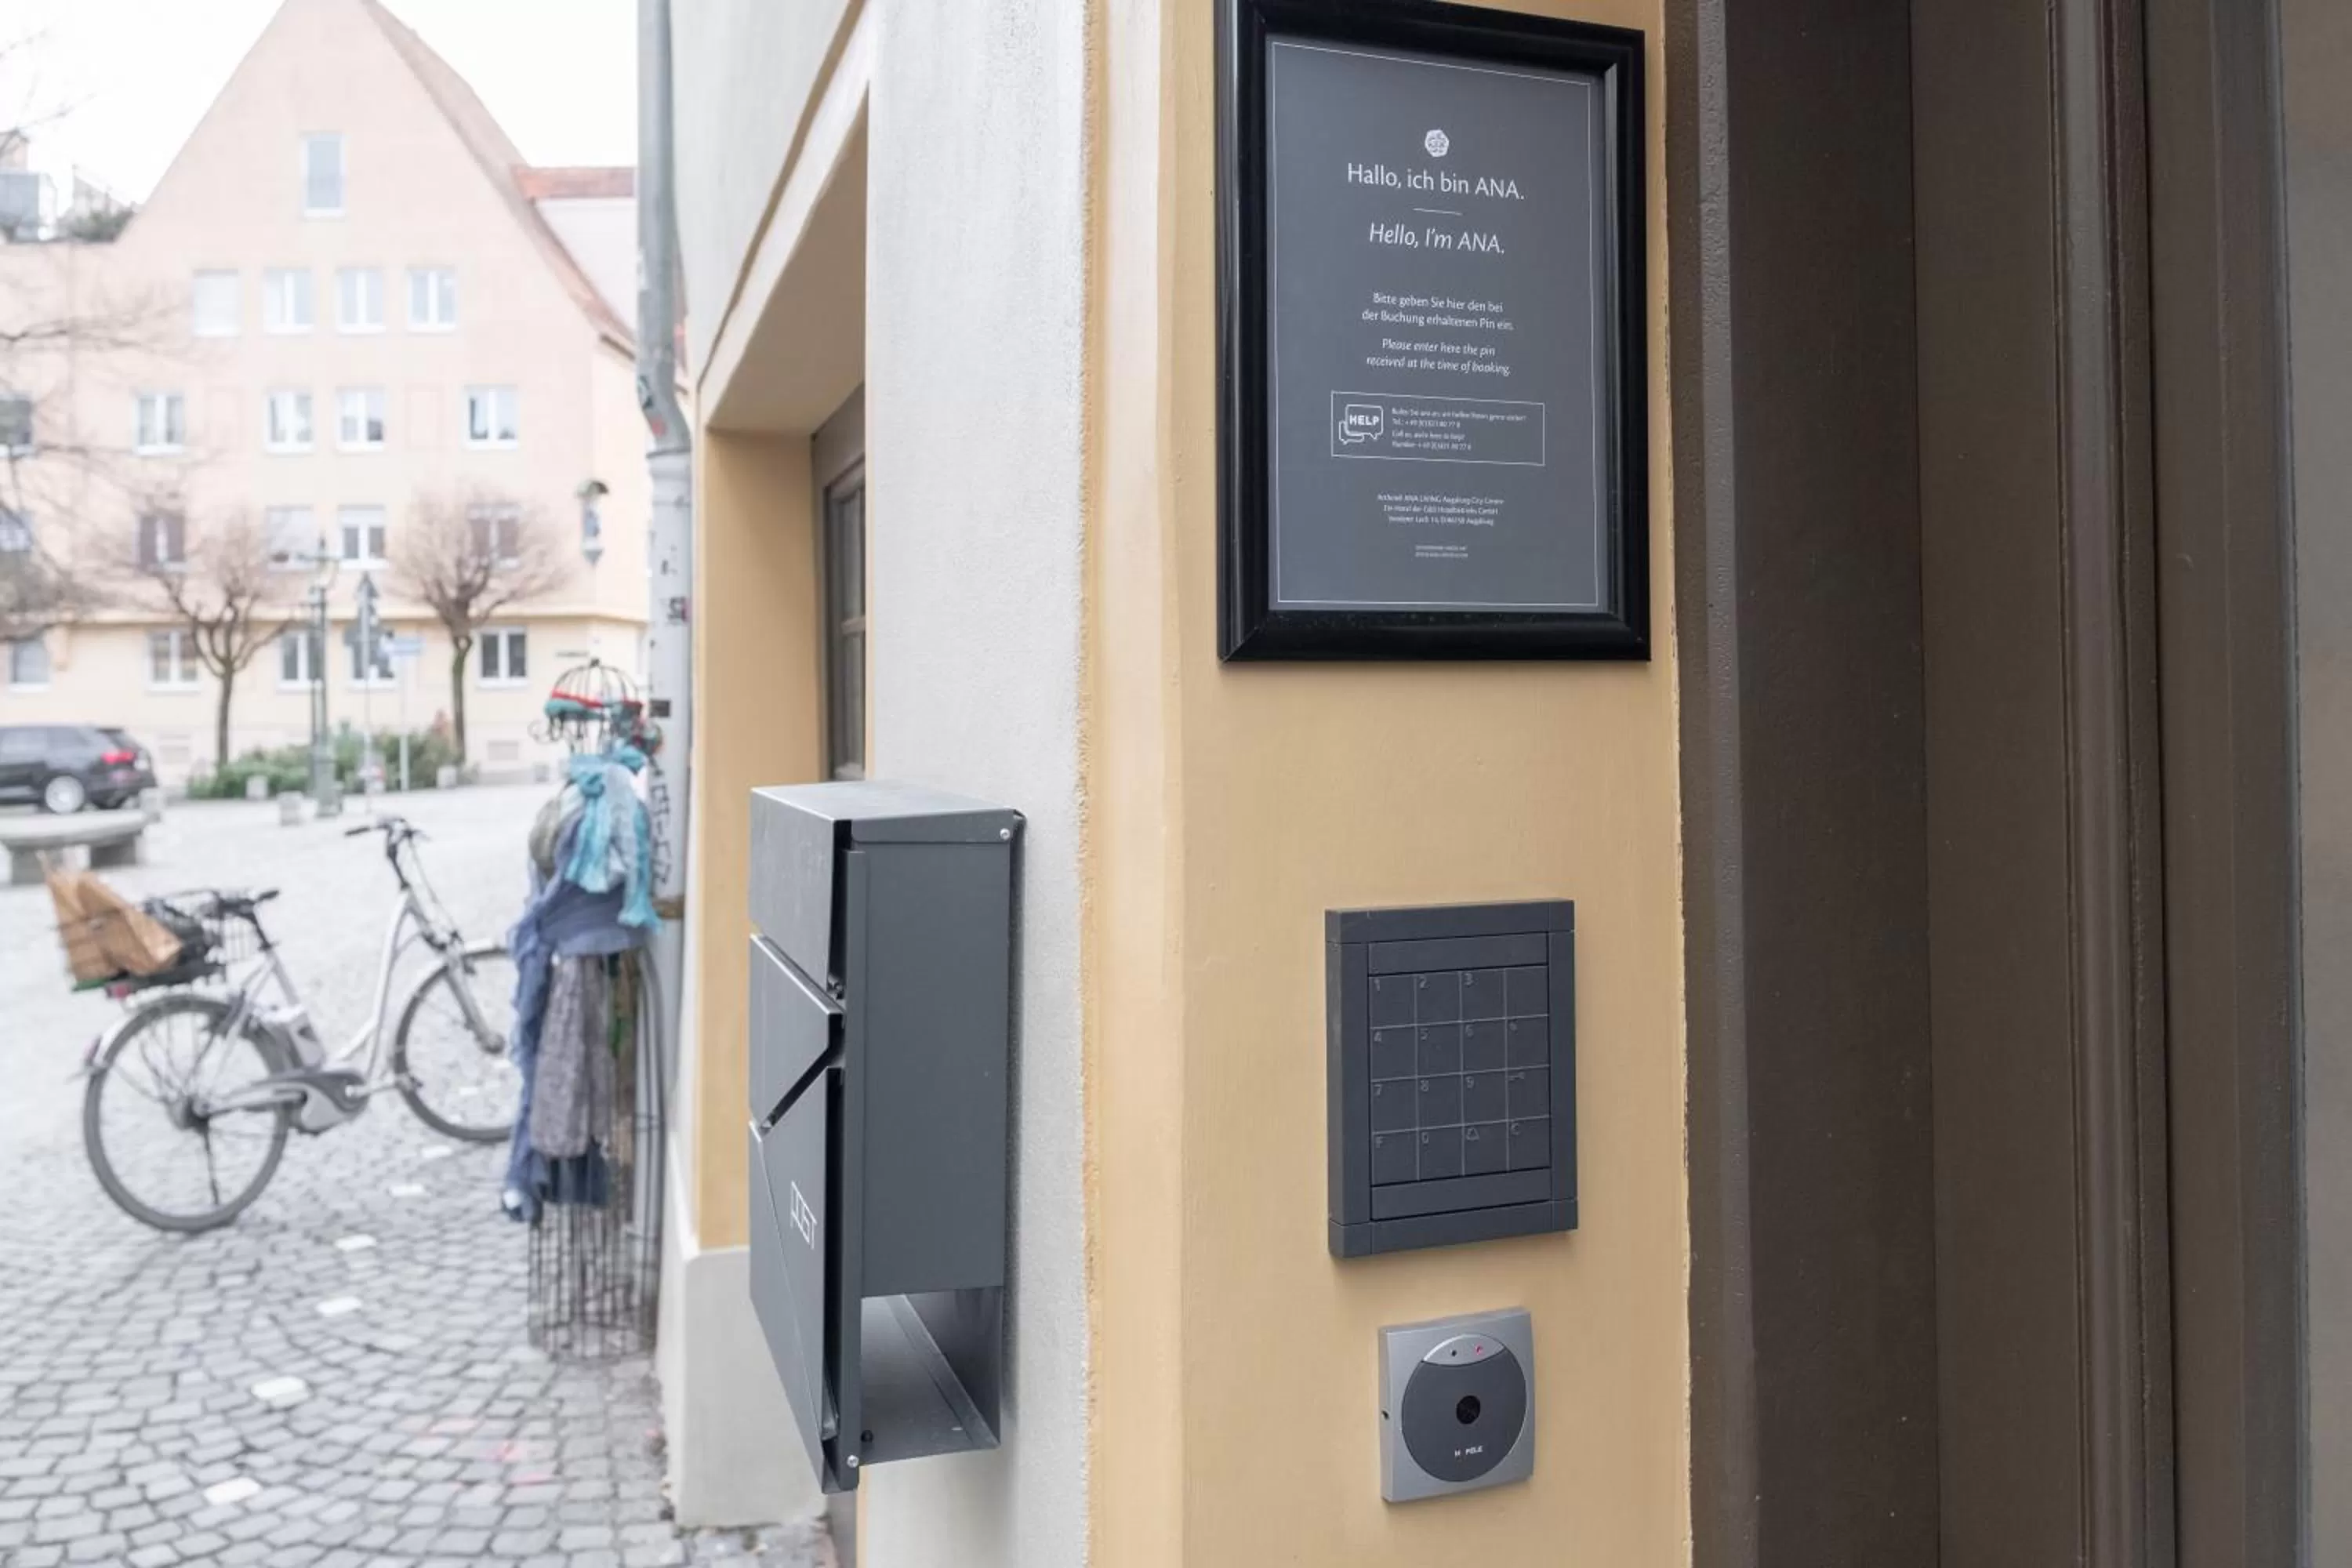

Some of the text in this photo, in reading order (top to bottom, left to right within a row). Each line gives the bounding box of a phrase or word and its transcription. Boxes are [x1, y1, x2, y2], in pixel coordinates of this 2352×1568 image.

[1348, 162, 1525, 200] Hallo, ich bin ANA.
[1369, 222, 1505, 255] Hello, I'm ANA.
[1373, 292, 1504, 313] Bitte geben Sie hier den bei
[1362, 309, 1379, 321] der
[1381, 310, 1425, 327] Buchung
[1479, 317, 1495, 330] Pin
[1382, 338, 1496, 358] Please enter here the pin
[1366, 355, 1406, 368] received
[1407, 359, 1417, 368] at
[1420, 358, 1436, 369] the
[1437, 359, 1458, 371] time
[1461, 360, 1472, 374] of
[1348, 414, 1380, 426] HELP
[1374, 972, 1474, 992] 1 2 3
[1420, 1080, 1429, 1092] 8
